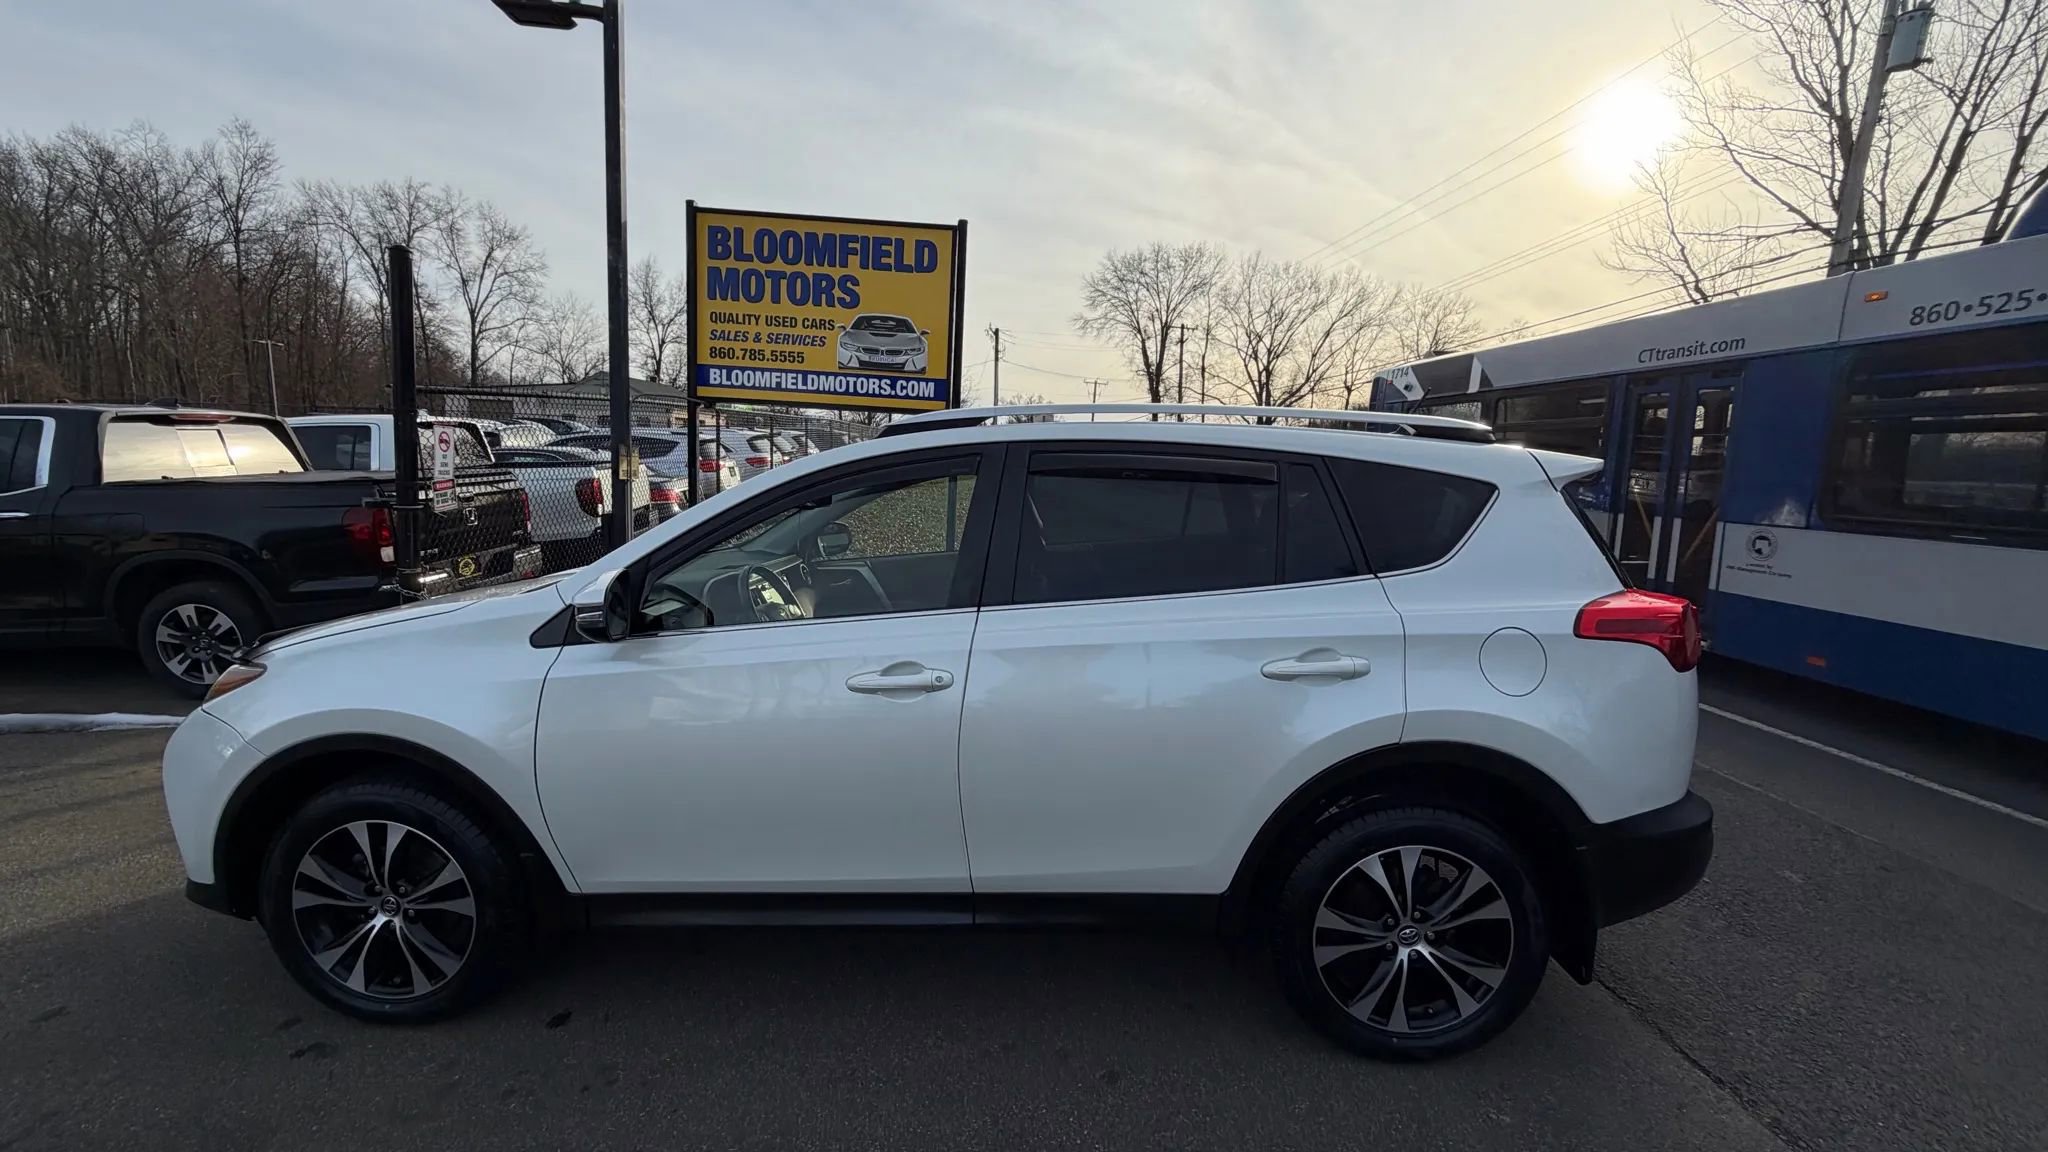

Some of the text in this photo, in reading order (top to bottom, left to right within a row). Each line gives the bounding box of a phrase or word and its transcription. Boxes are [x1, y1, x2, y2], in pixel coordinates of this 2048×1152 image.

[707, 225, 938, 274] BLOOMFIELD
[706, 266, 861, 309] MOTORS
[709, 311, 836, 331] QUALITY USED CARS
[709, 328, 827, 347] SALES & SERVICES
[709, 346, 805, 364] 860.785.5555
[1638, 338, 1745, 363] CTtransit.com
[709, 367, 935, 398] BLOOMFIELDMOTORS.COM
[1391, 367, 1409, 380] 1714
